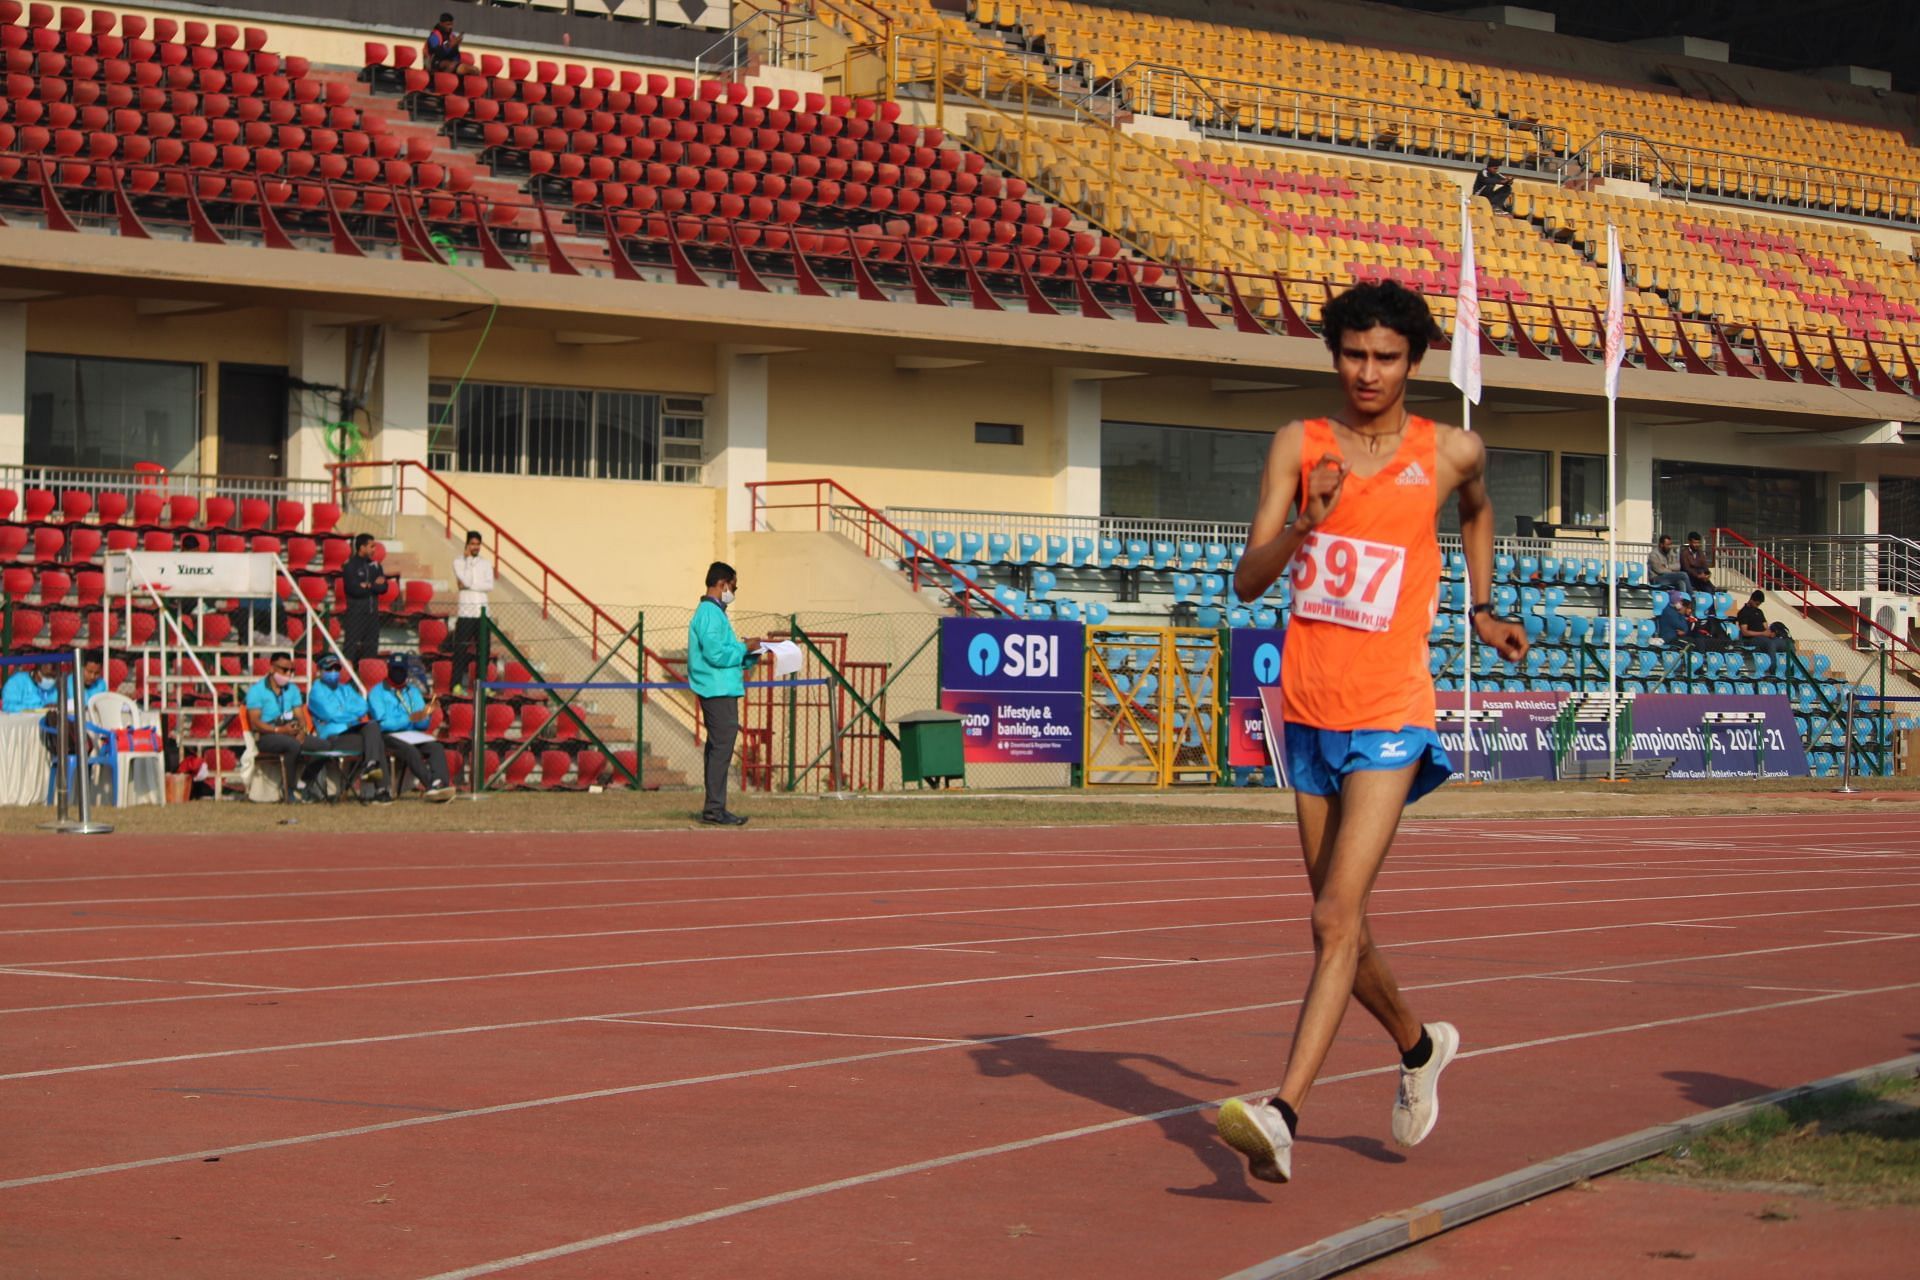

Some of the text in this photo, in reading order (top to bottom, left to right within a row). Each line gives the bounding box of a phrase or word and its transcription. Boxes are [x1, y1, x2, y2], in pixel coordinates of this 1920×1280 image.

[1395, 476, 1430, 485] adidas
[1290, 535, 1399, 604] 597
[1003, 633, 1059, 677] SBI
[997, 705, 1052, 721] Lifestyle &
[1482, 700, 1513, 710] Assam
[1515, 700, 1557, 711] Athletics
[997, 722, 1072, 738] banking, dono.
[1535, 727, 1608, 751] Atetics
